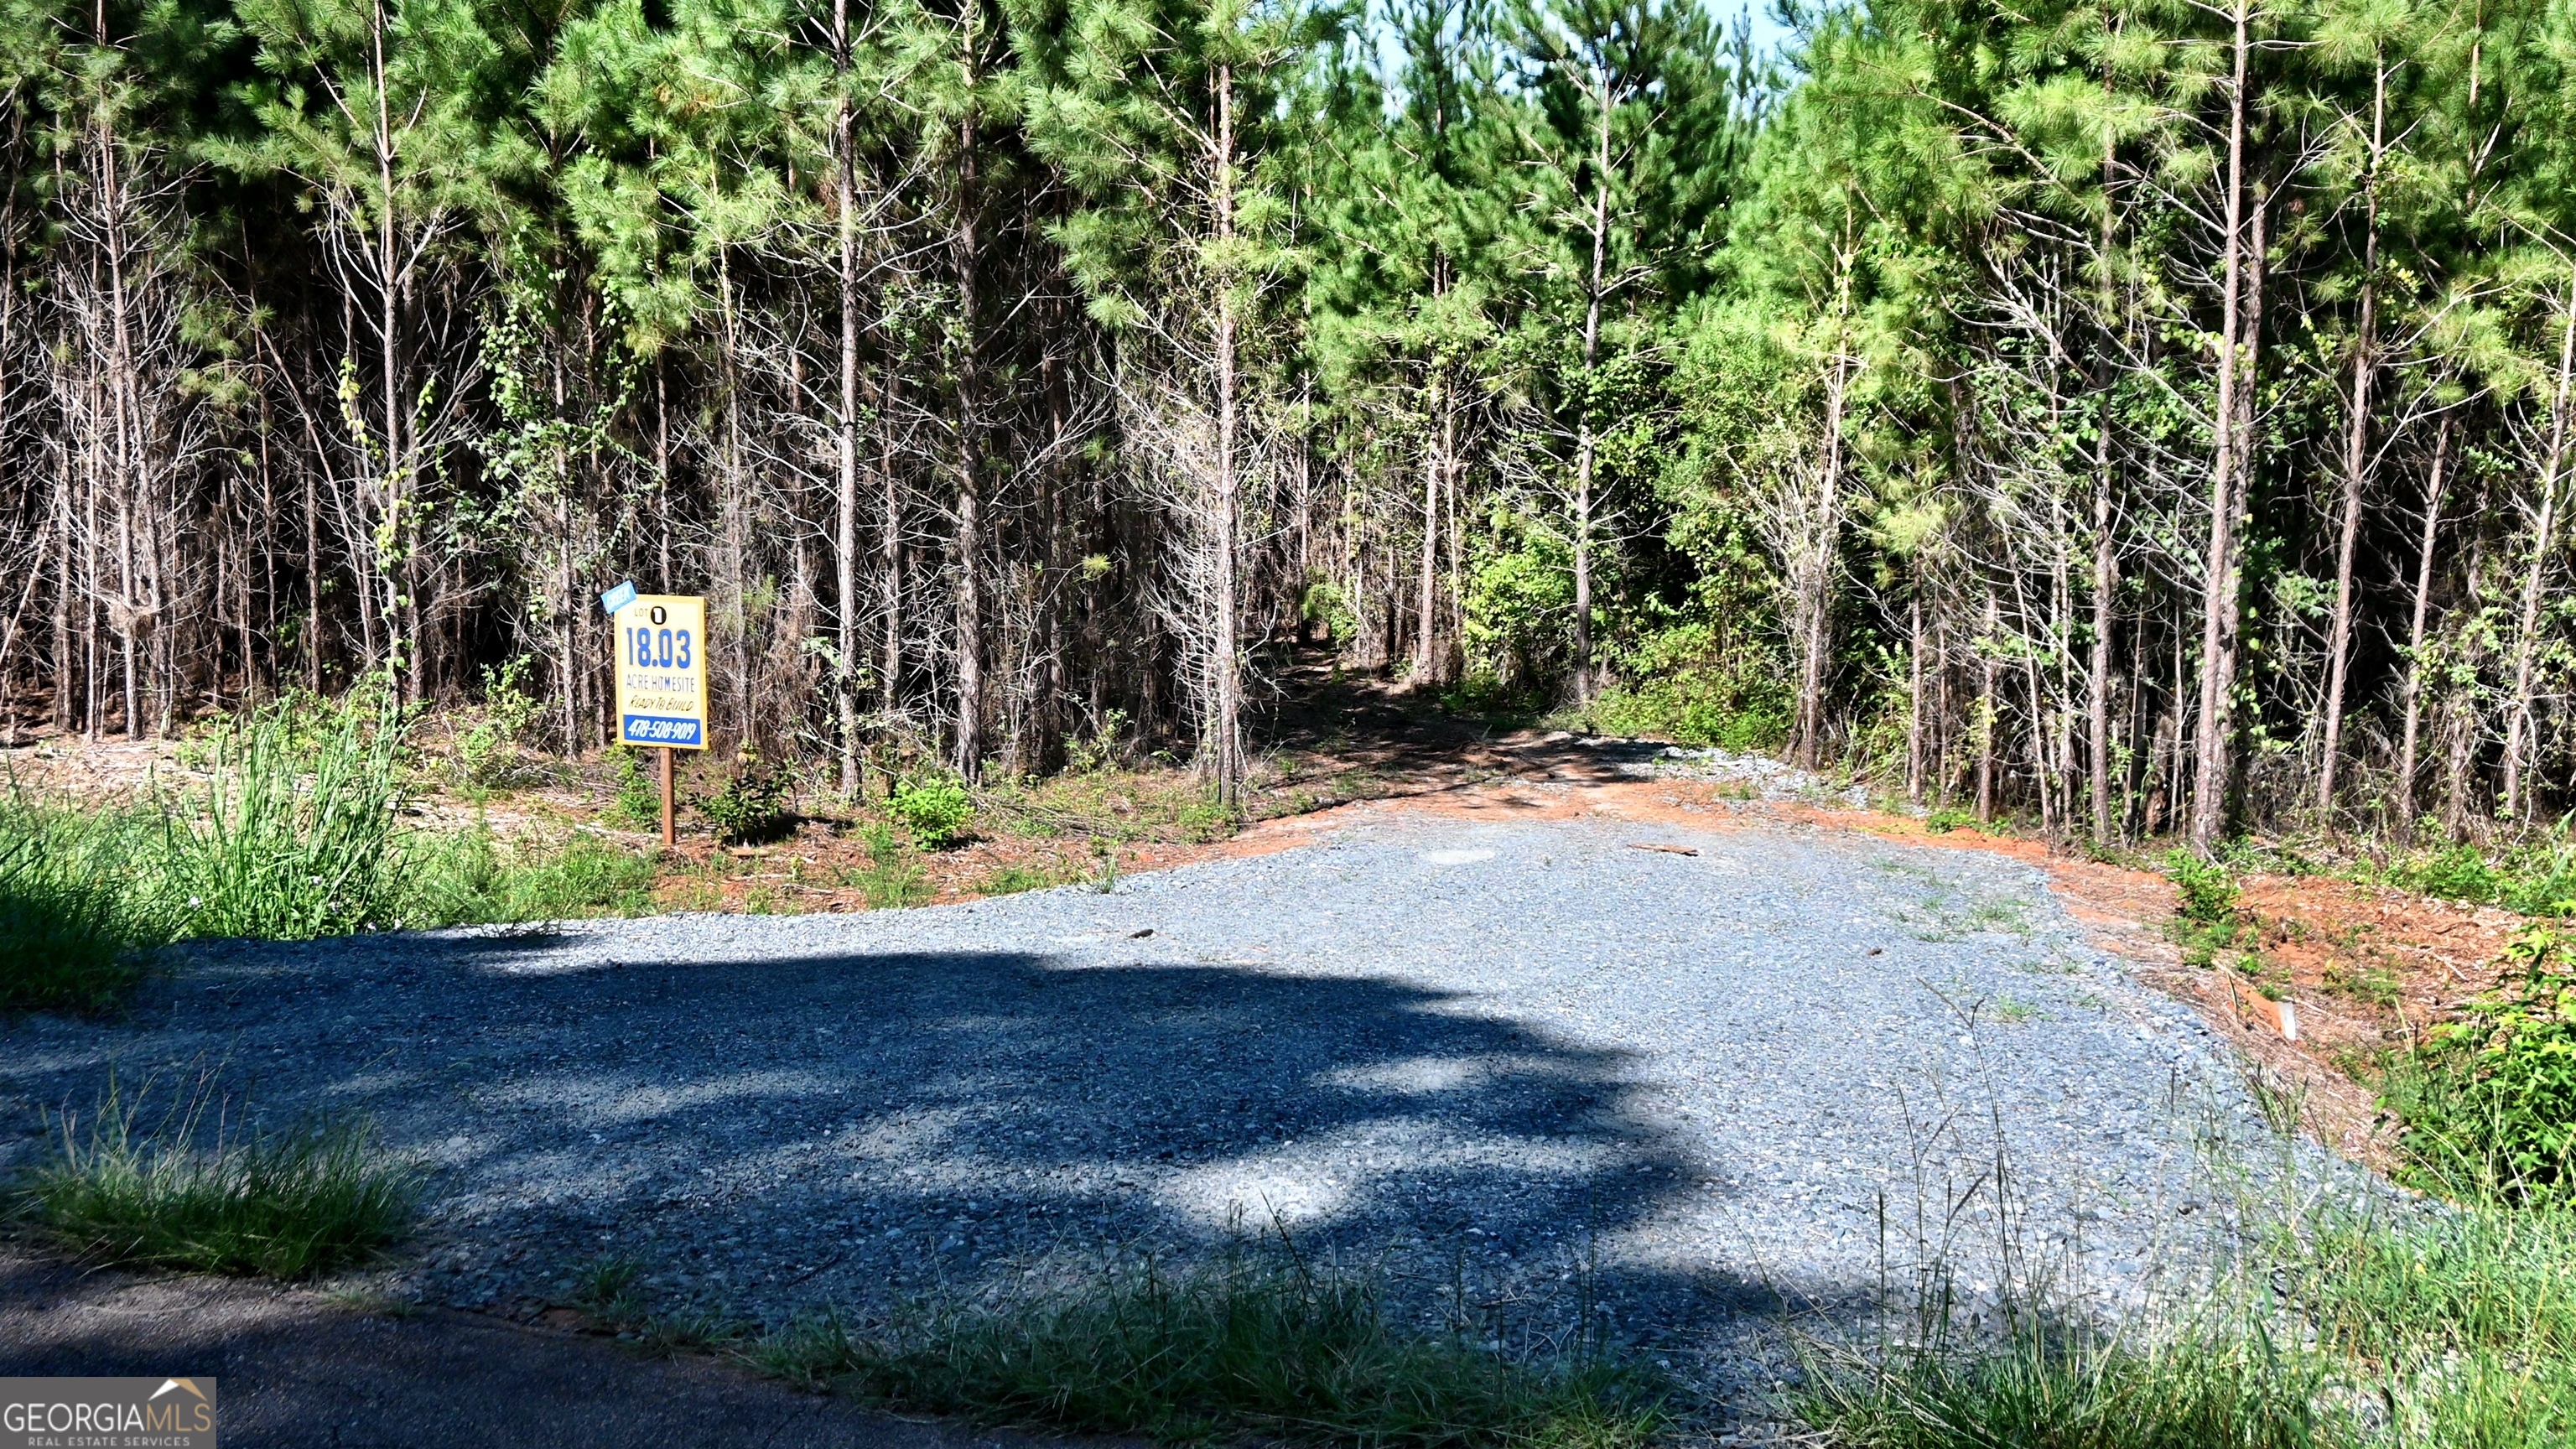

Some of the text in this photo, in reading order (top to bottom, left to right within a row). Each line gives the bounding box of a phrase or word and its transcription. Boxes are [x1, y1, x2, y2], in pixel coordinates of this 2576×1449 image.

[634, 608, 662, 623] LOT 1
[626, 627, 691, 669] 18.03
[626, 673, 694, 693] ACRE HOMESITE
[627, 719, 697, 740] 478-508-9019
